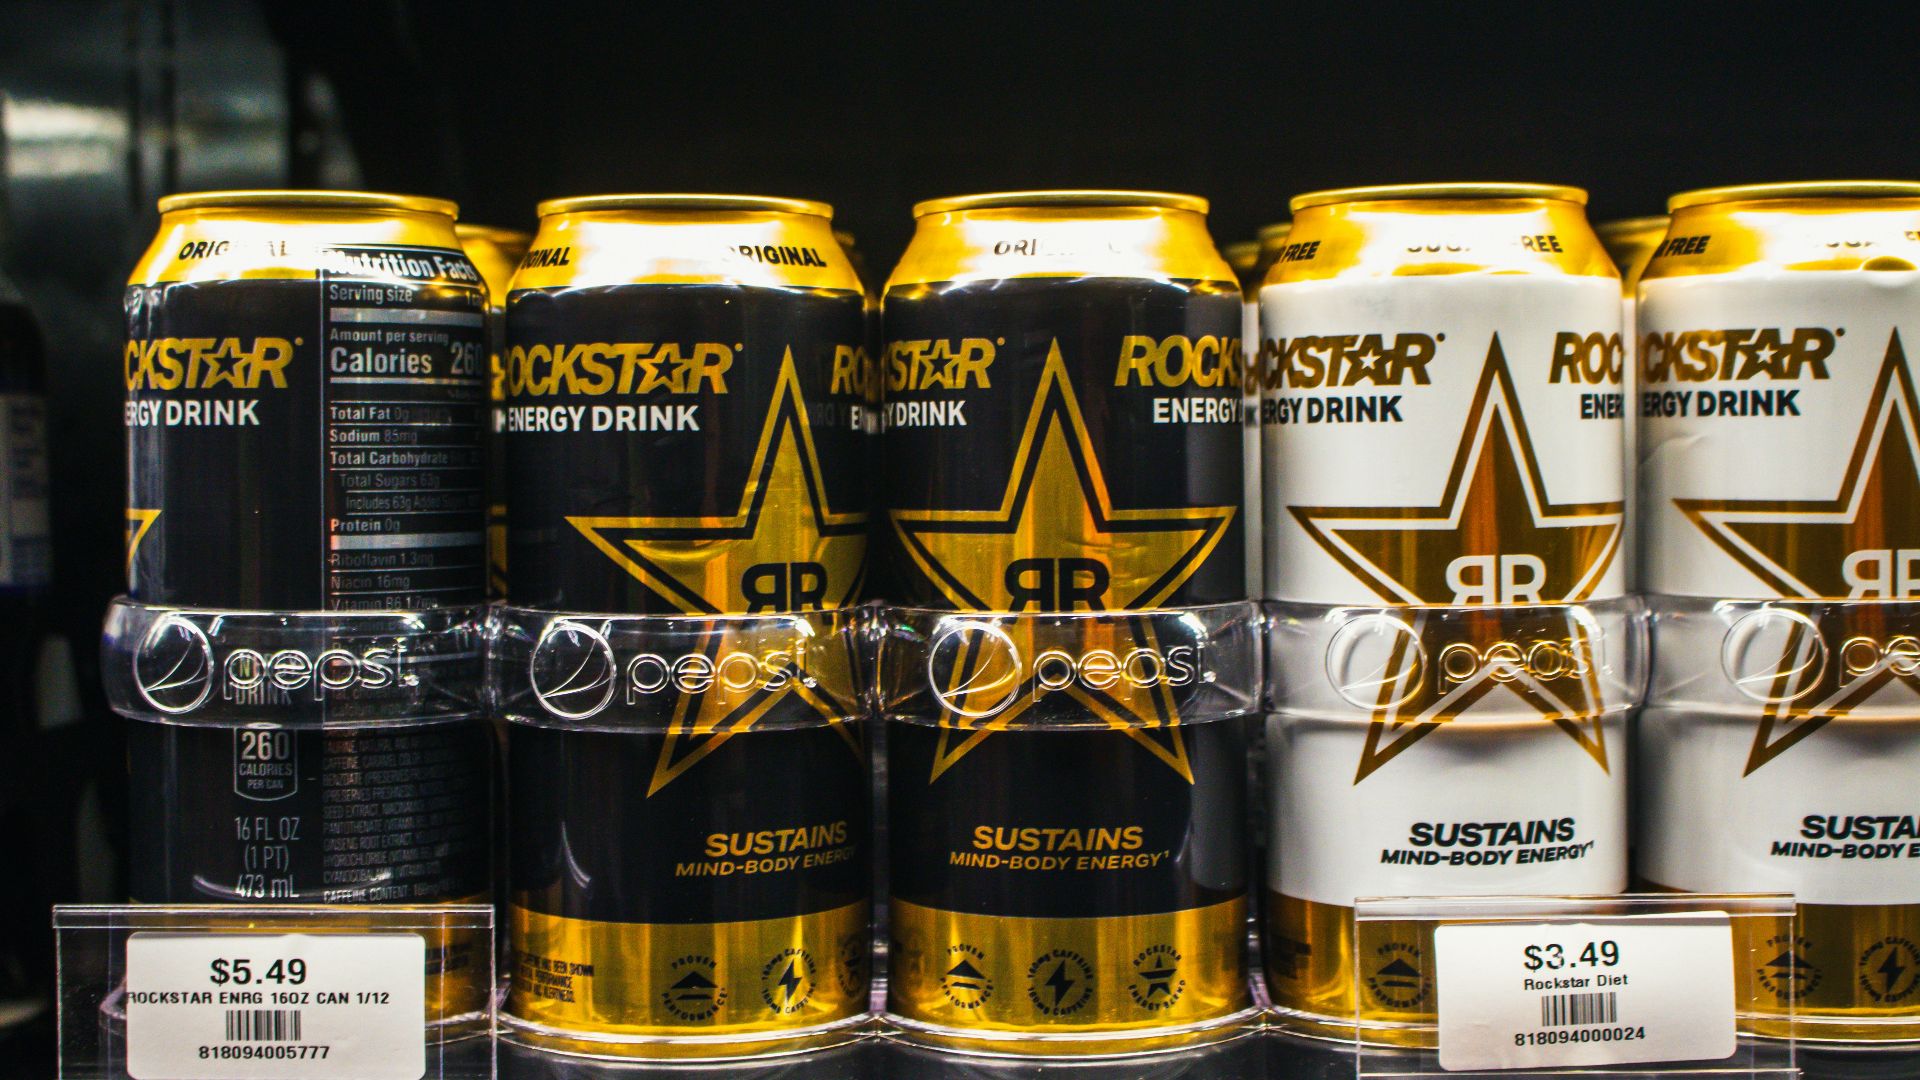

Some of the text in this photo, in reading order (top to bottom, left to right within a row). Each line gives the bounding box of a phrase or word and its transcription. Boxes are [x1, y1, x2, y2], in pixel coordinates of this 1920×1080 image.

[1283, 240, 1321, 263] FREE
[1515, 235, 1564, 253] REE
[1665, 235, 1712, 257] FREE
[728, 245, 827, 267] RIGINAL
[433, 255, 480, 281] Facts
[330, 284, 384, 304] Serving
[387, 286, 413, 302] size
[330, 328, 448, 346] Amount per serving
[331, 341, 483, 376] Calories 260
[883, 338, 996, 390] STAR
[1260, 333, 1437, 389] CKSTAR
[1638, 327, 1836, 382] CKSTAR
[506, 342, 733, 397] OCKSTAR
[165, 400, 260, 427] DRINK
[330, 407, 365, 420] Total
[369, 407, 391, 420] Fat
[898, 400, 967, 427] DRINK
[1153, 397, 1238, 424] ENERGY
[1307, 395, 1403, 424] DRINK
[1697, 389, 1800, 416] DRINK
[508, 405, 586, 432] ENERGY
[591, 405, 699, 432] DRINK
[330, 429, 380, 443] Sodium
[330, 451, 365, 465] Total
[369, 450, 448, 467] Carbohydrate
[340, 474, 371, 488] Total
[375, 474, 416, 489] Sugars
[330, 518, 400, 533] Protein 0g
[331, 553, 396, 567] Riboflavin
[331, 576, 372, 589] Niacin
[626, 649, 804, 705] pepsi
[241, 731, 290, 760] 260
[239, 763, 293, 777] CALORIES
[247, 779, 264, 789] PER
[235, 817, 300, 841] 16 FL OZ
[972, 825, 1143, 852] SUSTAINS
[1409, 817, 1576, 847] SUSTAINS
[1800, 814, 1920, 840] SUSTA
[705, 821, 847, 858] SUSTAINS
[1770, 841, 1902, 859] MIND-BODY
[244, 842, 289, 872] (1 PT)
[675, 855, 800, 877] MIND-BODY
[949, 851, 1071, 870] MIND-BODY
[1380, 847, 1510, 866] MIND-BODY
[234, 874, 300, 898] 473 mL
[1524, 940, 1620, 972] $3.49
[210, 958, 307, 985] $5.49
[1524, 974, 1629, 991] Rockstar Diet
[128, 992, 213, 1005] ROCKSTAR
[219, 992, 263, 1004] ENRG
[316, 992, 349, 1005] CAN
[357, 992, 390, 1005] 1/12
[1514, 1026, 1646, 1047] 818094000024
[199, 1046, 330, 1060] 818094005777
